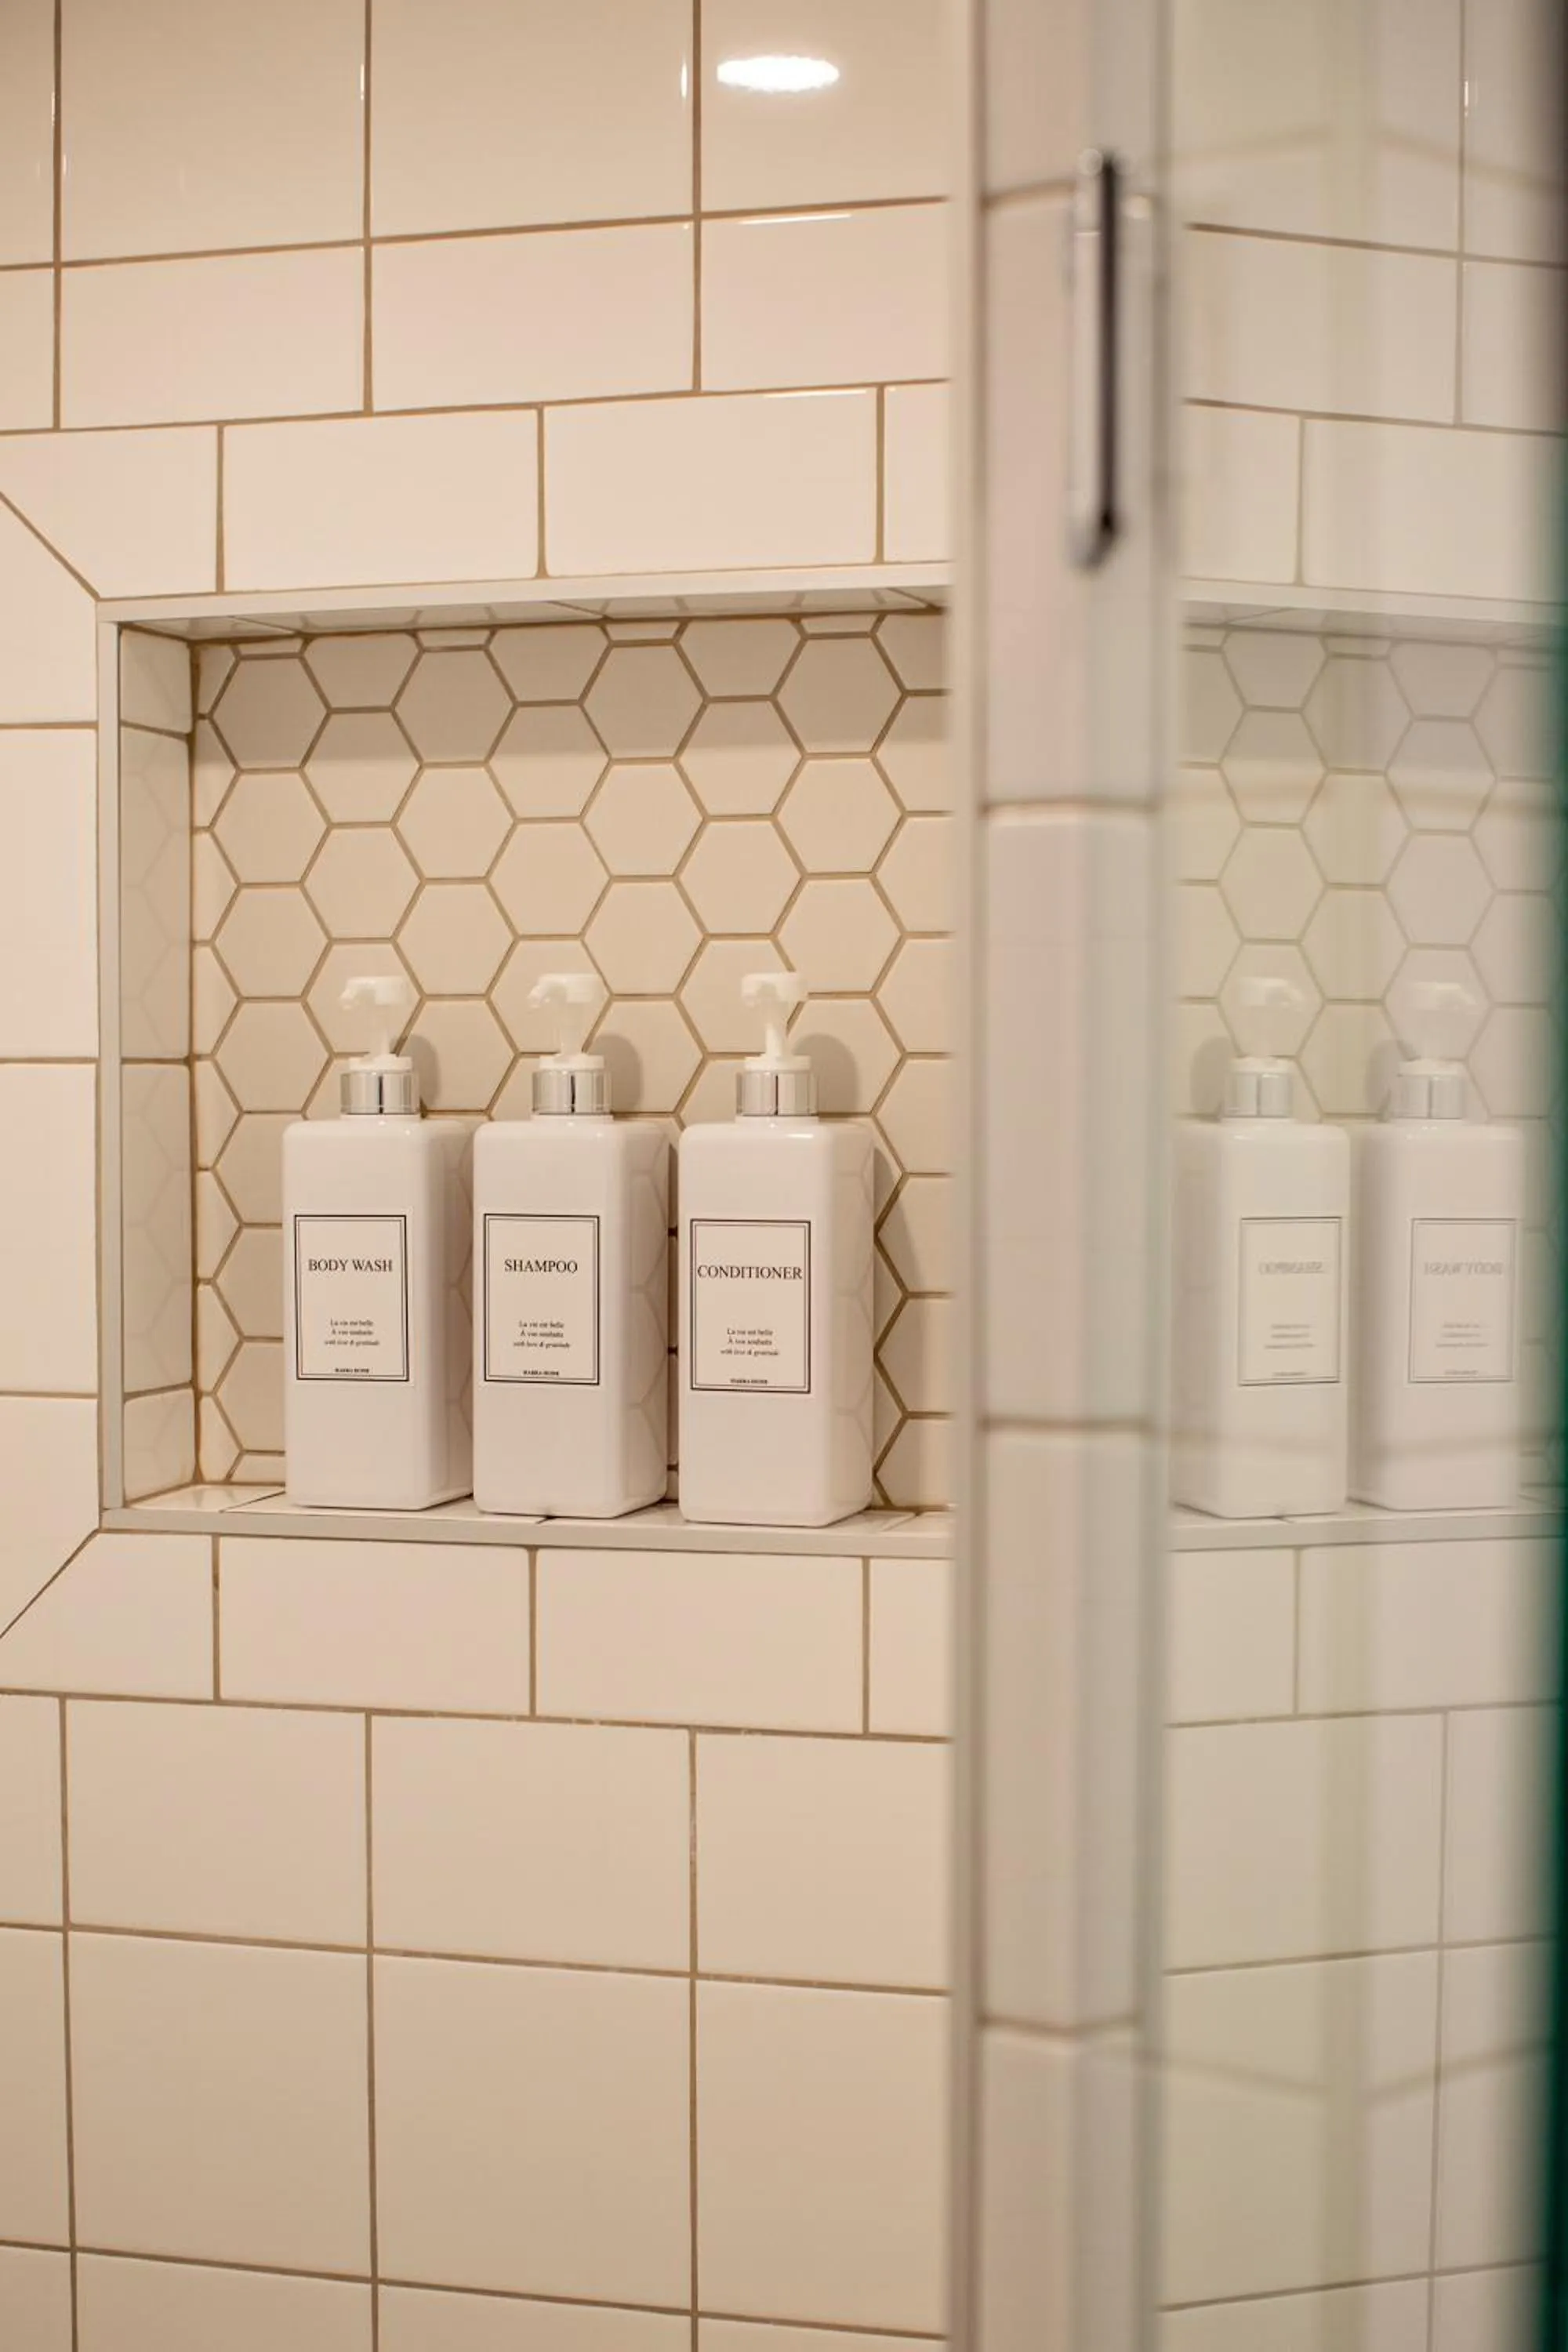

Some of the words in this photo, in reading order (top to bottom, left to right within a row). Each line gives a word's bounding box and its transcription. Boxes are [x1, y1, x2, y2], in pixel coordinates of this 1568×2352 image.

[308, 1258, 348, 1272] BODY
[351, 1259, 392, 1272] WASH
[504, 1258, 578, 1273] SHAMPOO
[697, 1264, 802, 1279] CONDITIONER
